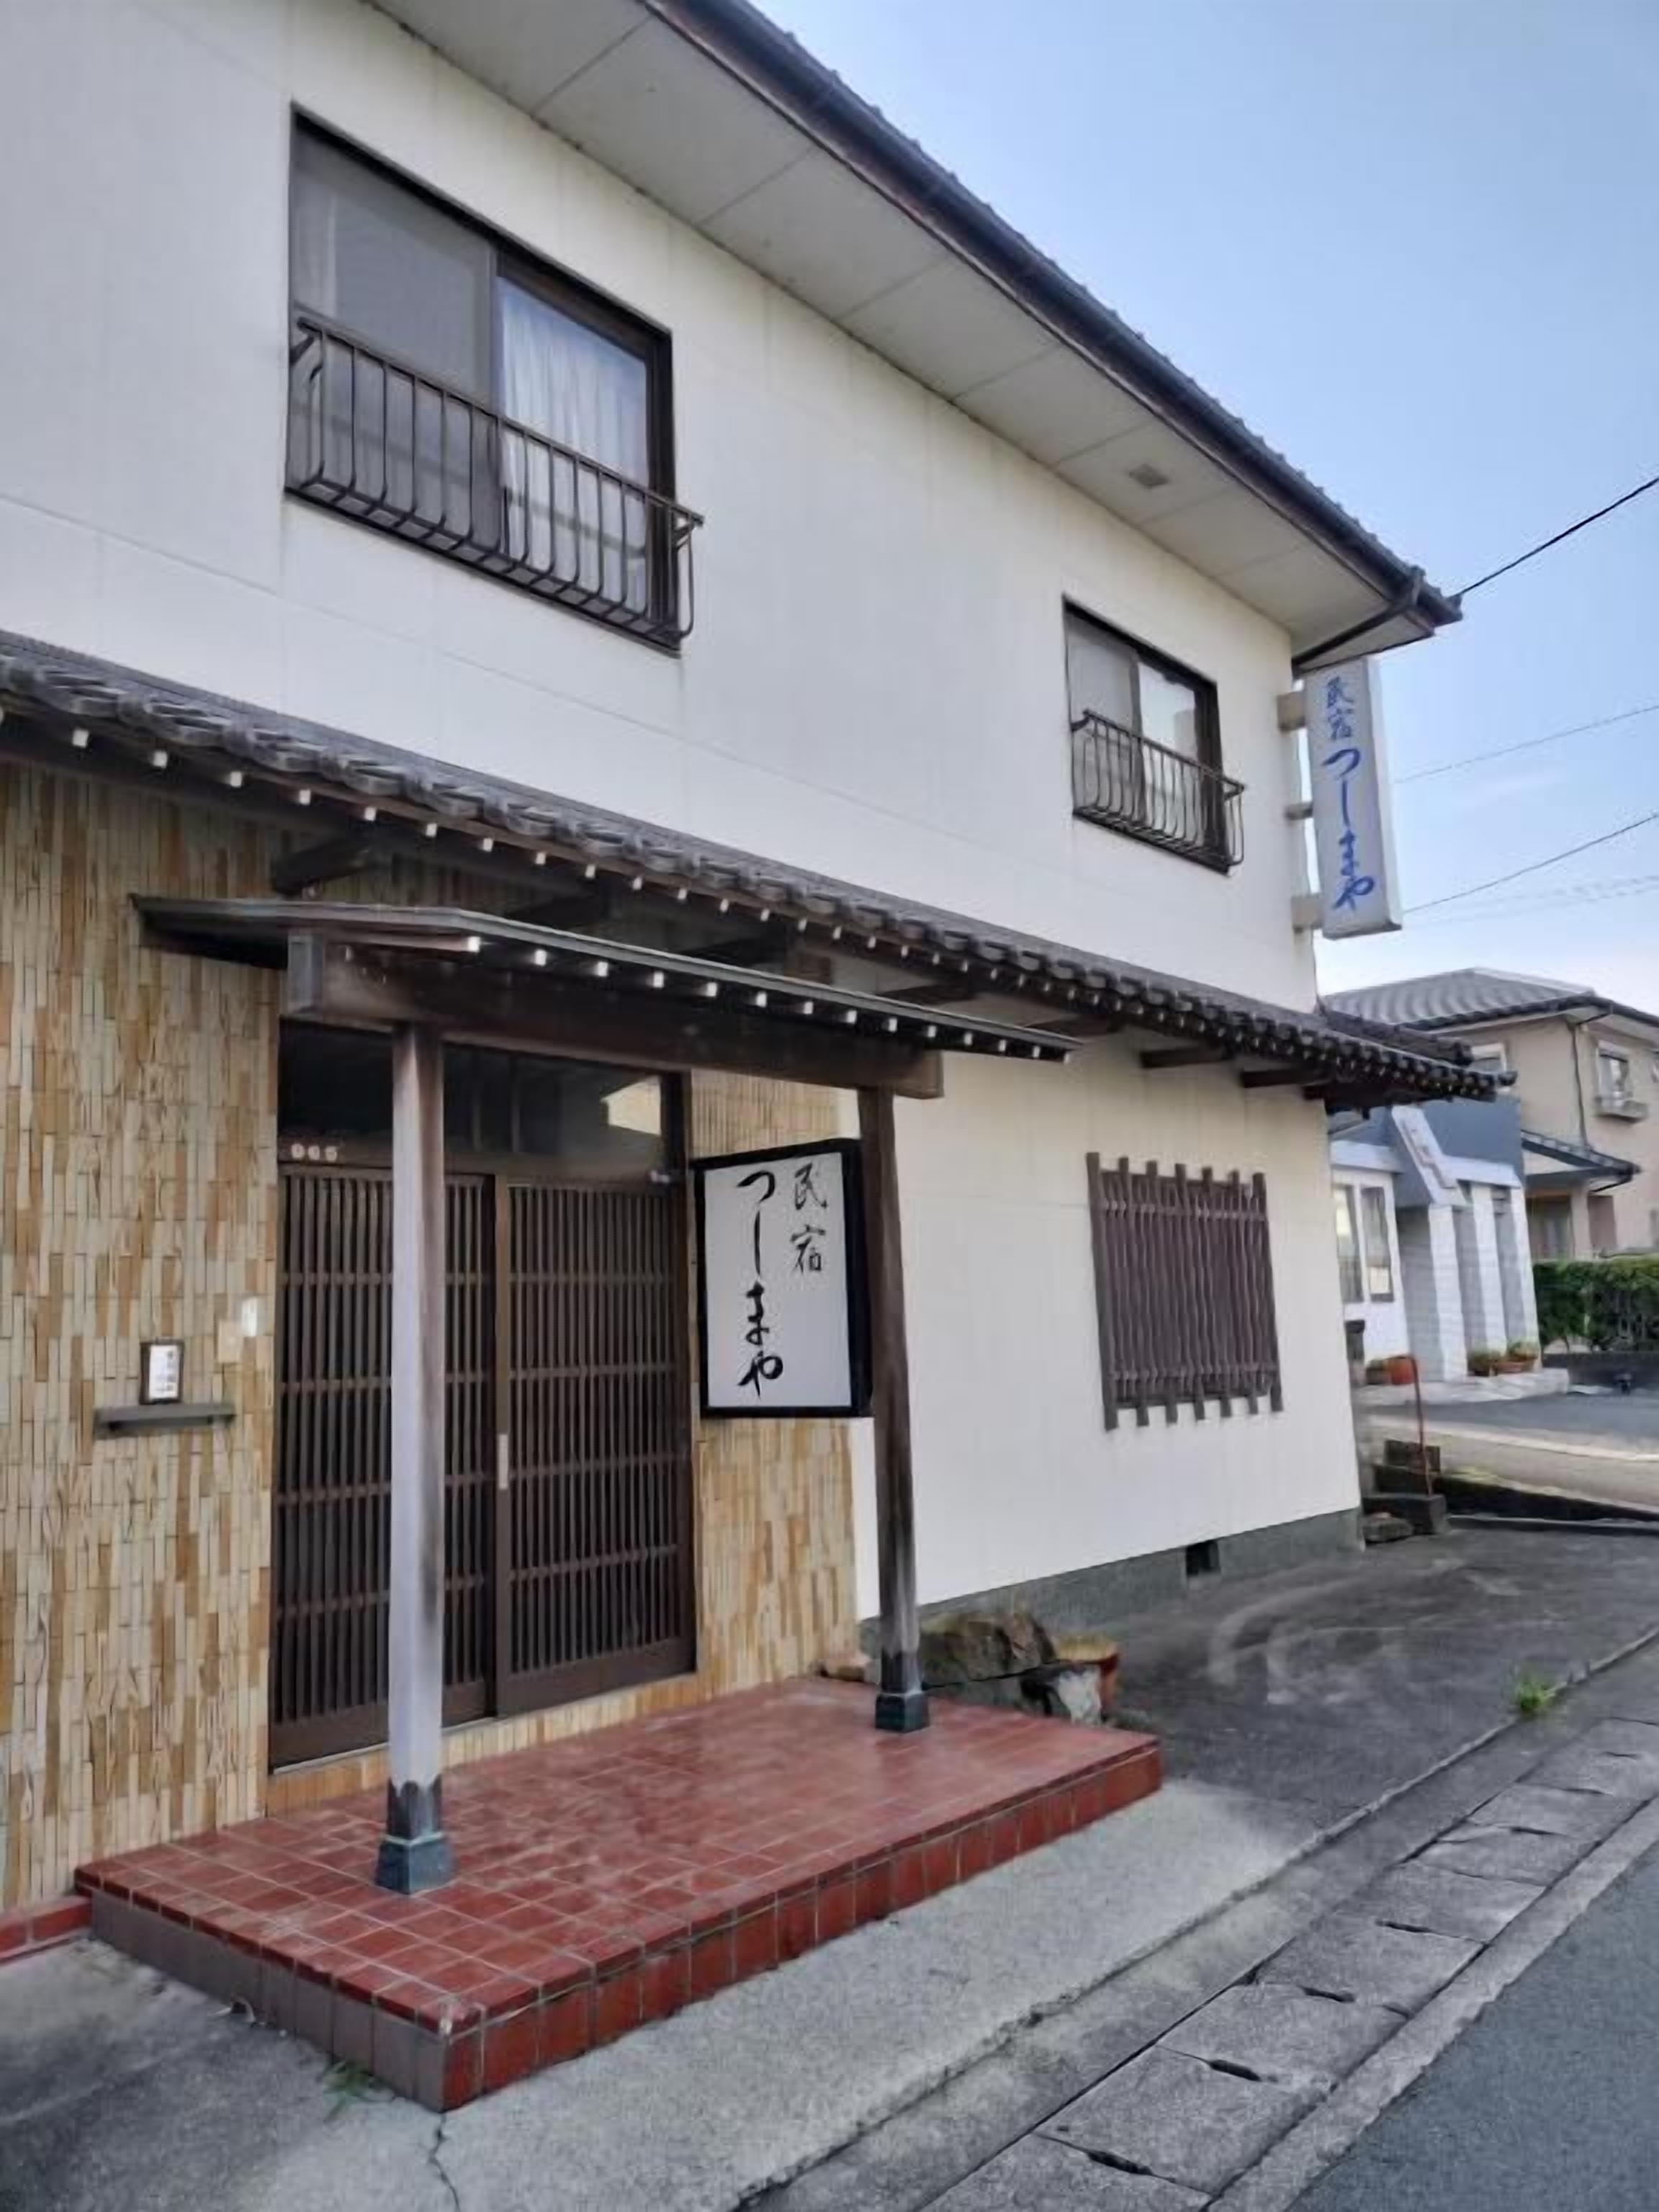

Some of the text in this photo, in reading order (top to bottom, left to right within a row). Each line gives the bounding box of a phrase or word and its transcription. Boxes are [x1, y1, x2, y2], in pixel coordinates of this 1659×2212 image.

[737, 1169, 784, 1400] つしまや
[790, 1161, 828, 1276] 民宿
